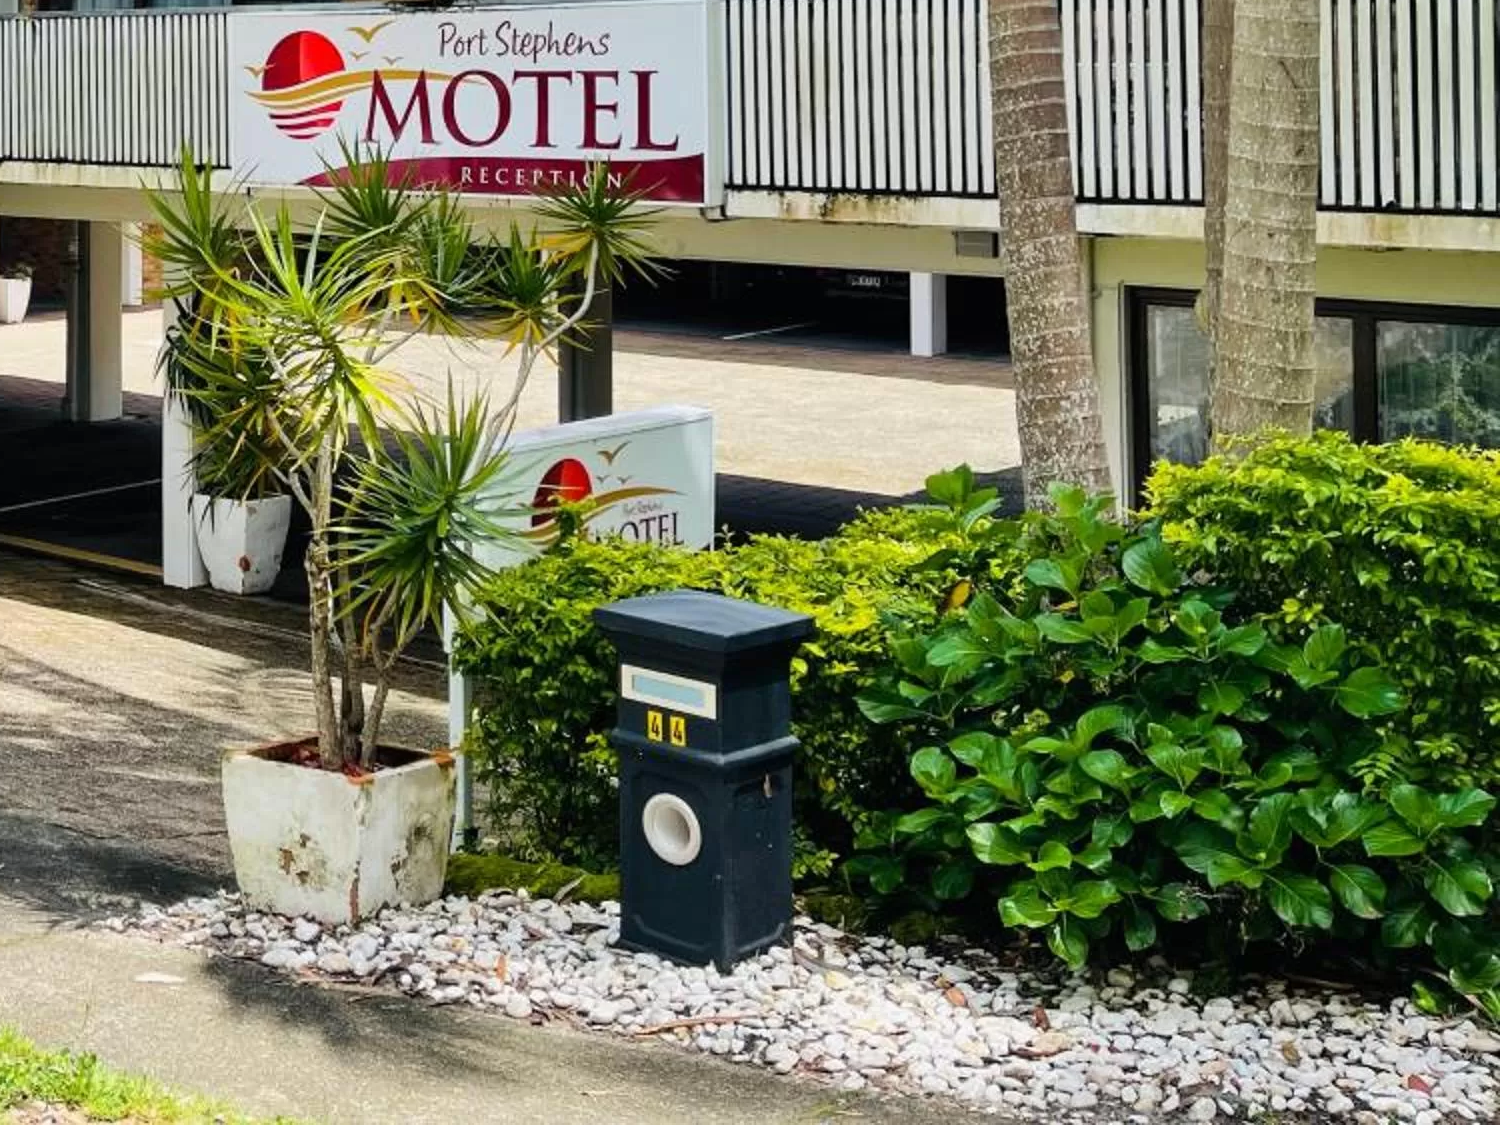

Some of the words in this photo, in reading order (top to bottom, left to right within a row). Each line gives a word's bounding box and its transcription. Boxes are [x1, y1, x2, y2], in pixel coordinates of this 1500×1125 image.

[437, 22, 488, 57] Port
[495, 20, 611, 64] Stephens
[362, 69, 680, 151] MOTEL
[594, 511, 684, 546] OTEL
[651, 715, 683, 743] 44
